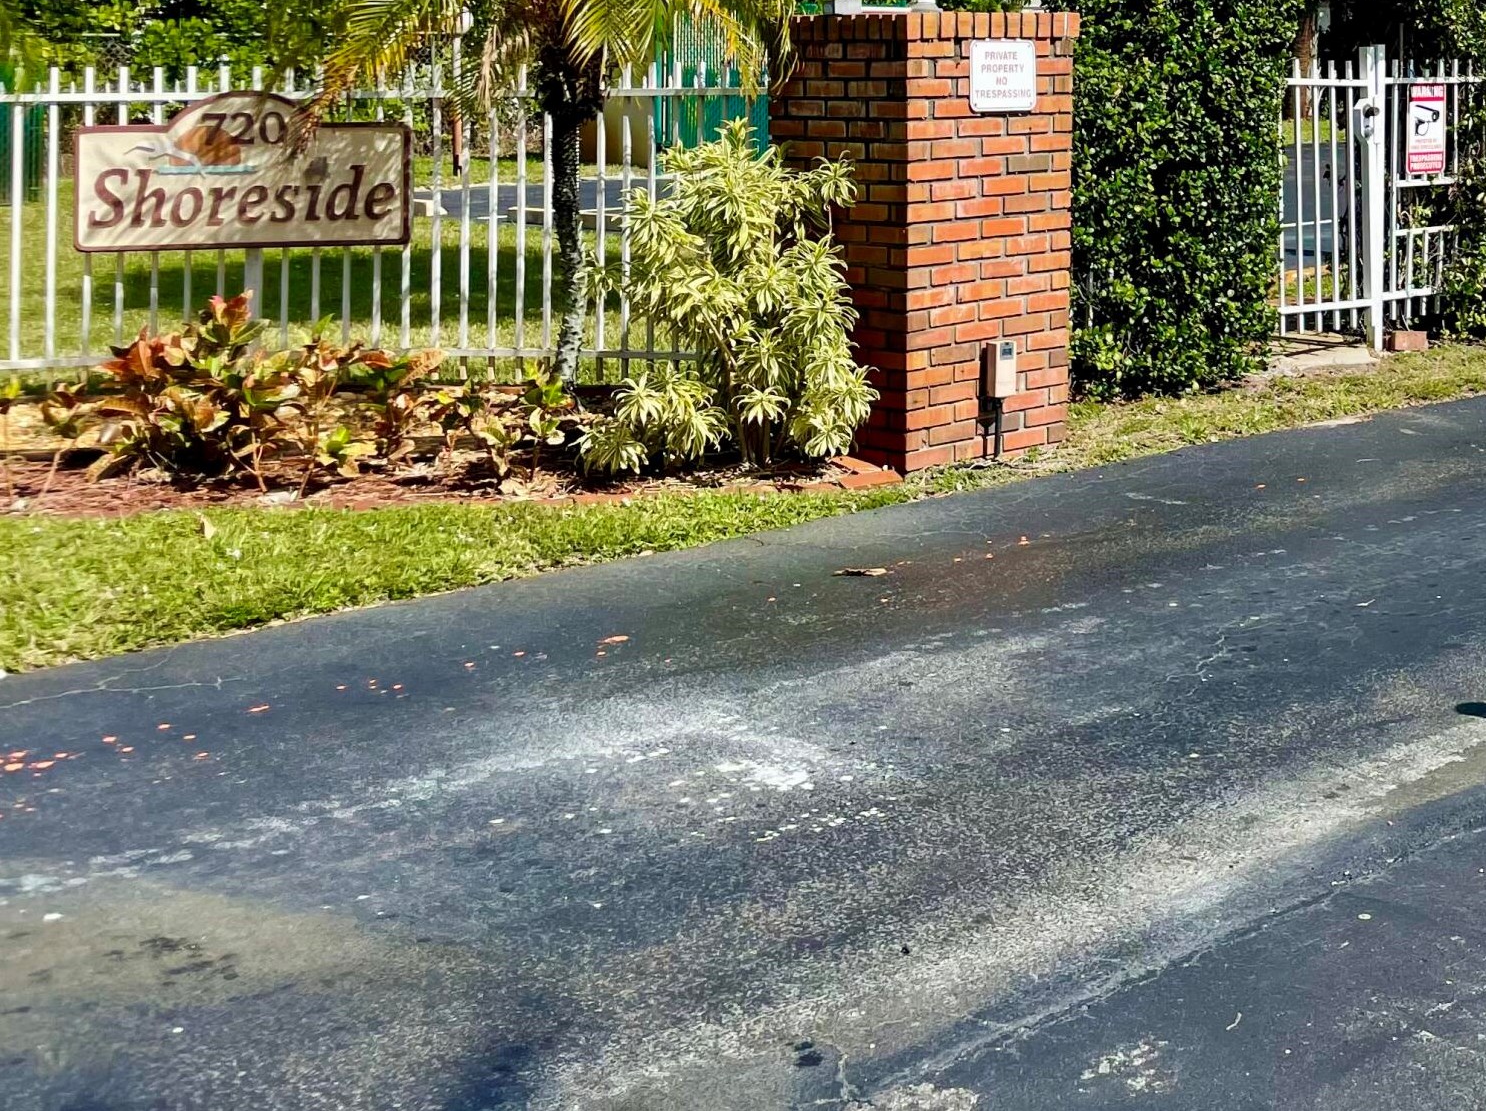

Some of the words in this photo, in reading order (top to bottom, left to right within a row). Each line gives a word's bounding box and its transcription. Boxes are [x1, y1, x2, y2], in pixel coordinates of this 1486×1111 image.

[984, 51, 1018, 60] PRIVATE
[981, 63, 1025, 73] PROPERTY
[995, 76, 1008, 86] NO
[975, 89, 1032, 99] TRESPASSING
[1410, 85, 1445, 98] WARNING
[200, 111, 289, 146] 720
[88, 164, 396, 229] Shoreside
